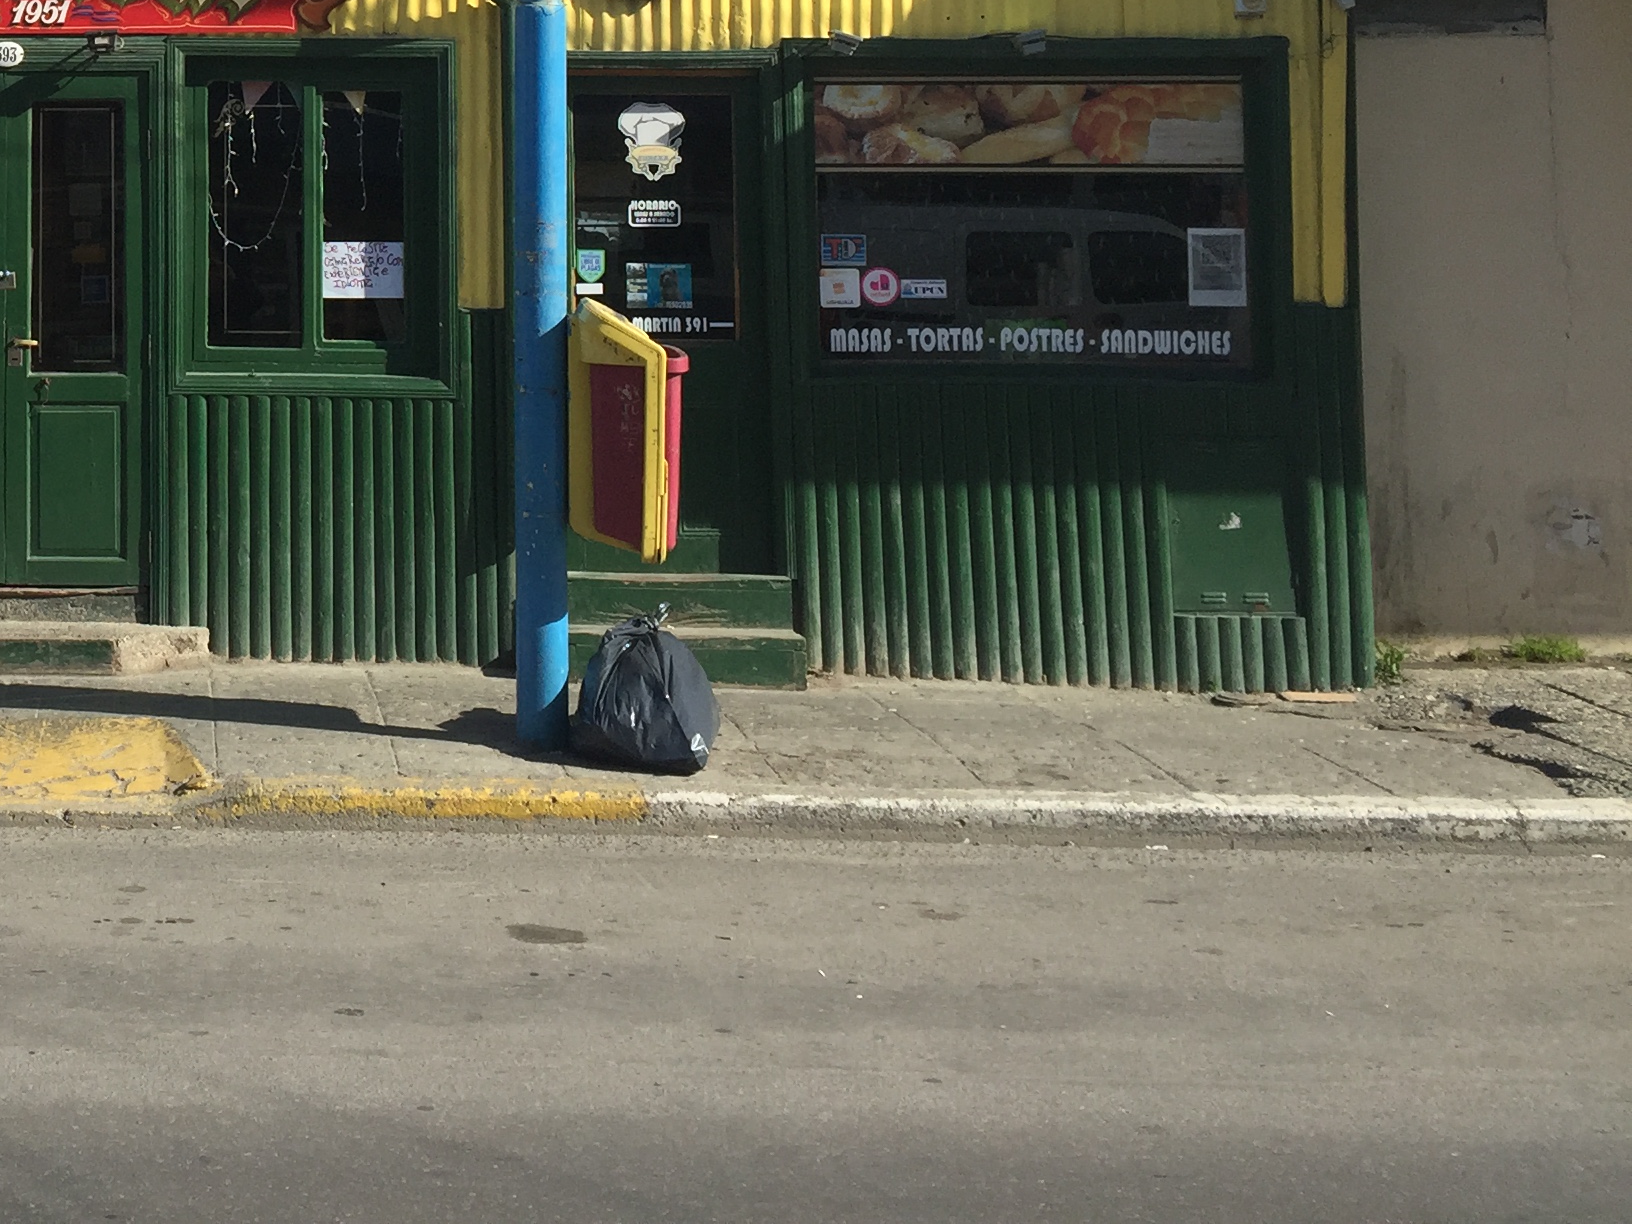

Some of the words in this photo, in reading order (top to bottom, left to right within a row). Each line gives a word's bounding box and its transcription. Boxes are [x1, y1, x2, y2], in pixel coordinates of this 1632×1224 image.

[12, 0, 71, 24] 1951
[631, 200, 677, 210] HORARIO
[686, 317, 708, 333] 391
[830, 328, 892, 352] MASAS
[907, 327, 984, 352] TORTAS
[1000, 328, 1085, 353] POSTRES
[1100, 329, 1231, 356] SANDWICHES
